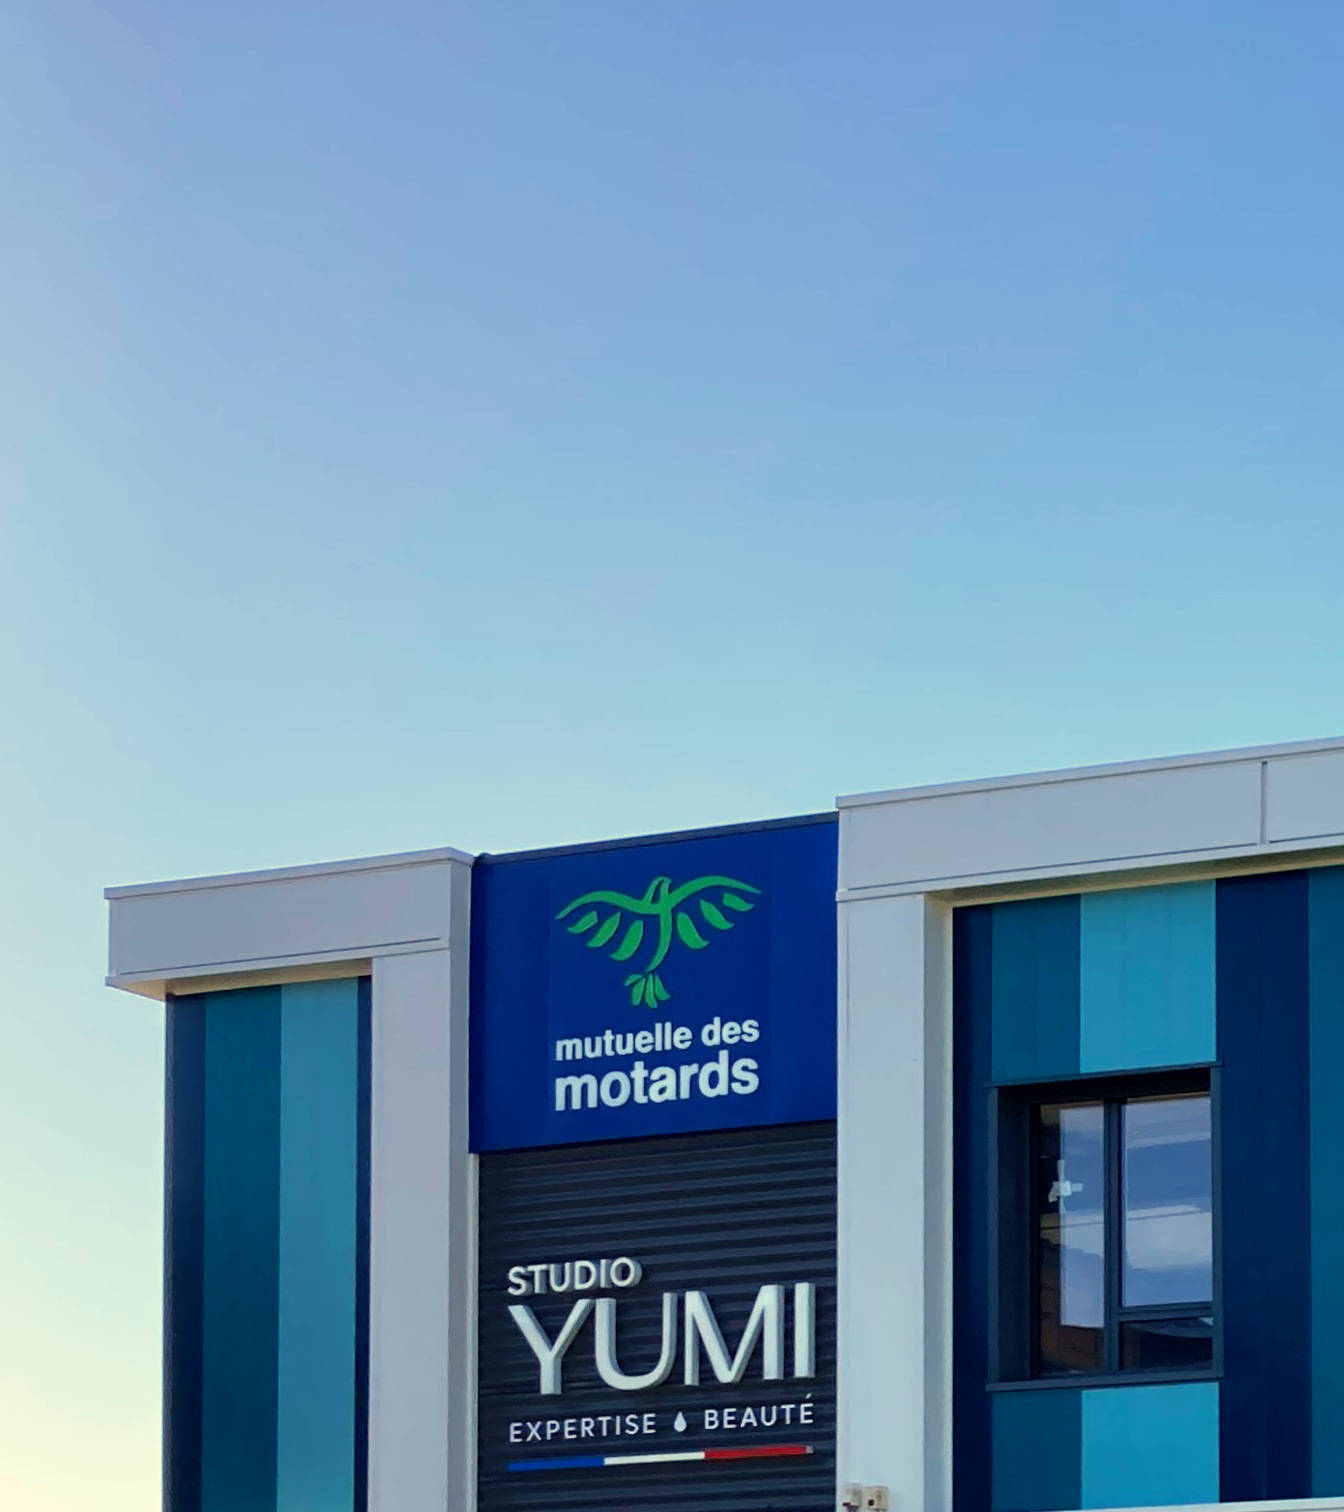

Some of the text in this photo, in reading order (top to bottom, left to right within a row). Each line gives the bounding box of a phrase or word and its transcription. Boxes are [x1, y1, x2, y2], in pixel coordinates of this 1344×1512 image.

[555, 1016, 760, 1061] mutuelle des
[554, 1052, 760, 1111] motards
[507, 1257, 640, 1295] STUDIO
[507, 1281, 815, 1395] YUMI
[509, 1393, 814, 1443] EXPERTISE BEAUTÉ
